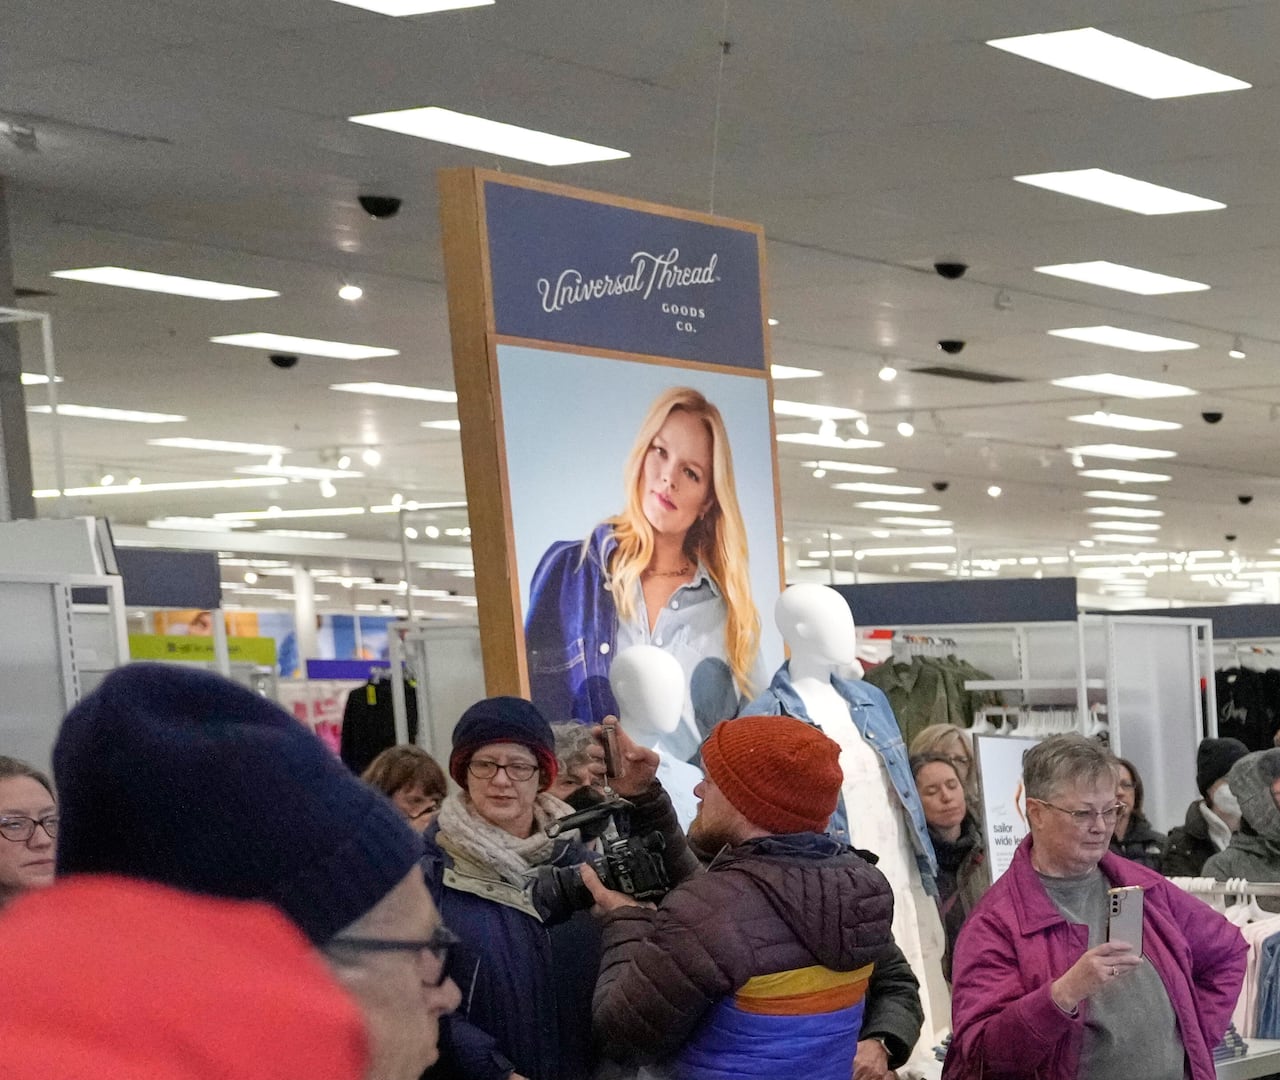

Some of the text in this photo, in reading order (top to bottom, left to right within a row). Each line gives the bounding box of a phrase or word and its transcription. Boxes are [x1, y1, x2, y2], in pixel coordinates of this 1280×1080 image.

[537, 247, 719, 313] Universal Thread
[661, 303, 706, 319] GOODS
[676, 320, 697, 333] CO.
[993, 822, 1013, 833] sailor
[994, 836, 1013, 846] wide
